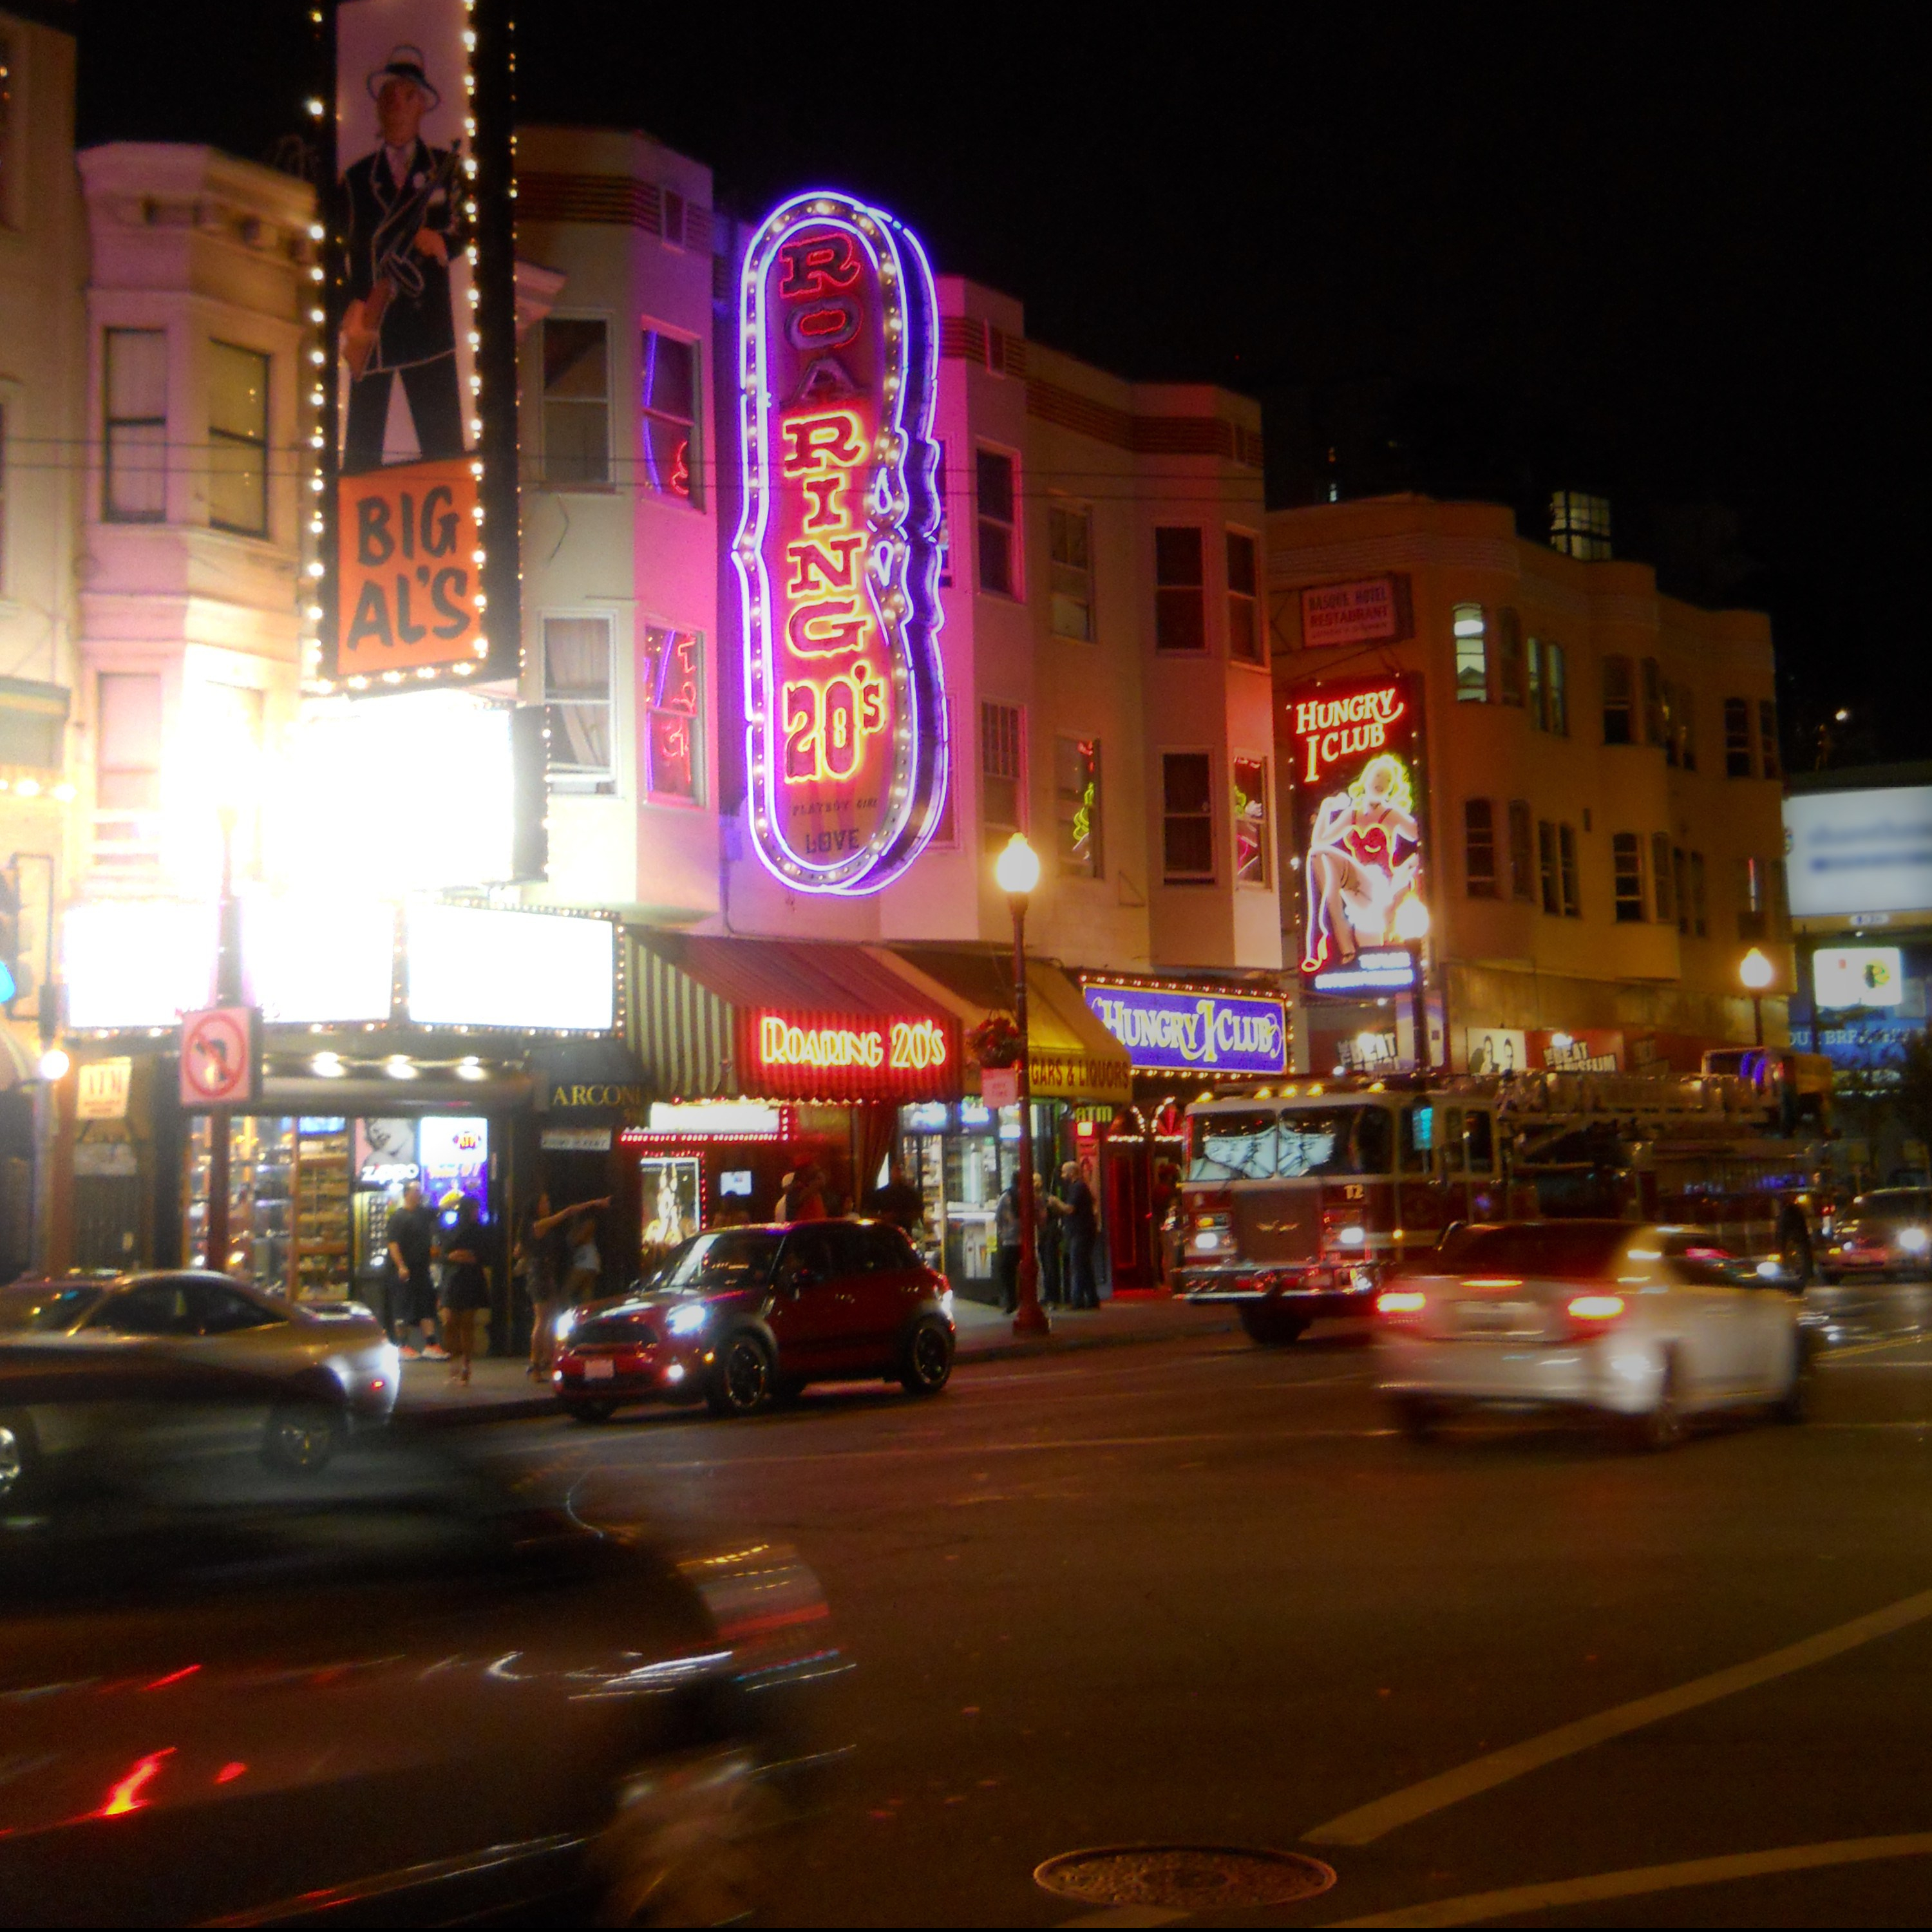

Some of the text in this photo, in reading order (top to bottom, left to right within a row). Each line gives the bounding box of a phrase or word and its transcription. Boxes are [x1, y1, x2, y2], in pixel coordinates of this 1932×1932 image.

[779, 232, 872, 658] ROARING
[356, 486, 460, 567] BIG
[346, 565, 471, 651] AL'S
[1296, 688, 1404, 734] HUNGRY
[1304, 723, 1385, 782] I CLUB
[805, 828, 860, 855] LOVE
[761, 1016, 884, 1068] ROARING
[1093, 997, 1202, 1060] HUNGRY
[1215, 1009, 1283, 1059] CLUB
